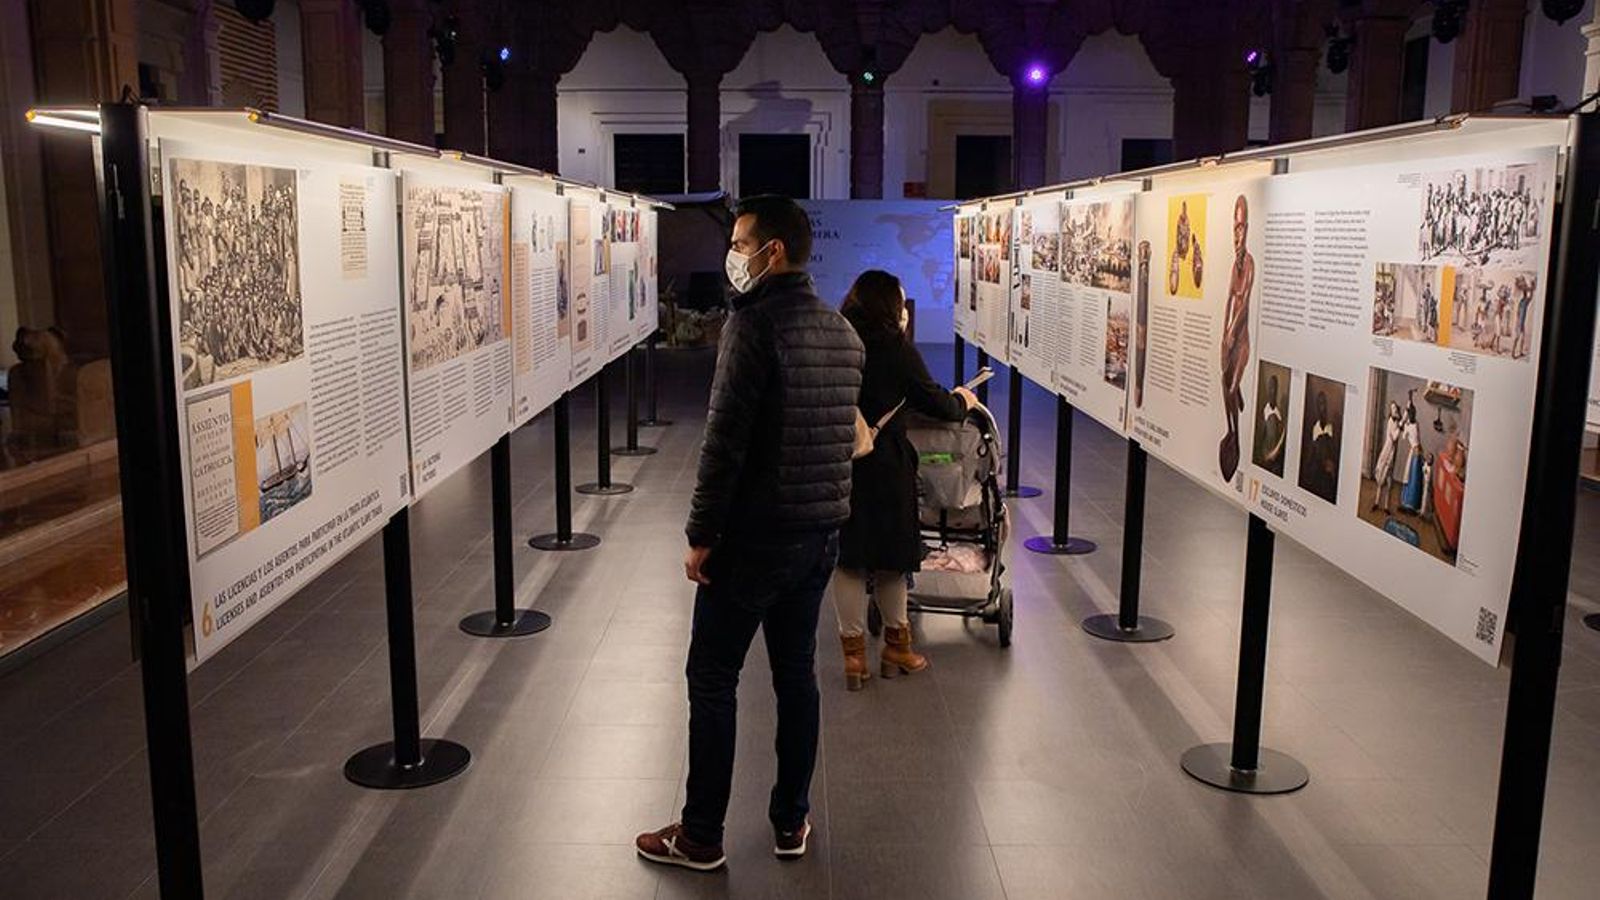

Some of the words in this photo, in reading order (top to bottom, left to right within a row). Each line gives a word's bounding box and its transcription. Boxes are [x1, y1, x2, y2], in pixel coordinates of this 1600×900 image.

[214, 590, 227, 609] LAS
[227, 570, 258, 600] LICENCIAS
[263, 559, 274, 576] LOS
[216, 601, 245, 631] LICENSES
[245, 591, 258, 609] AND
[284, 566, 295, 580] FOR
[202, 602, 212, 637] 6
